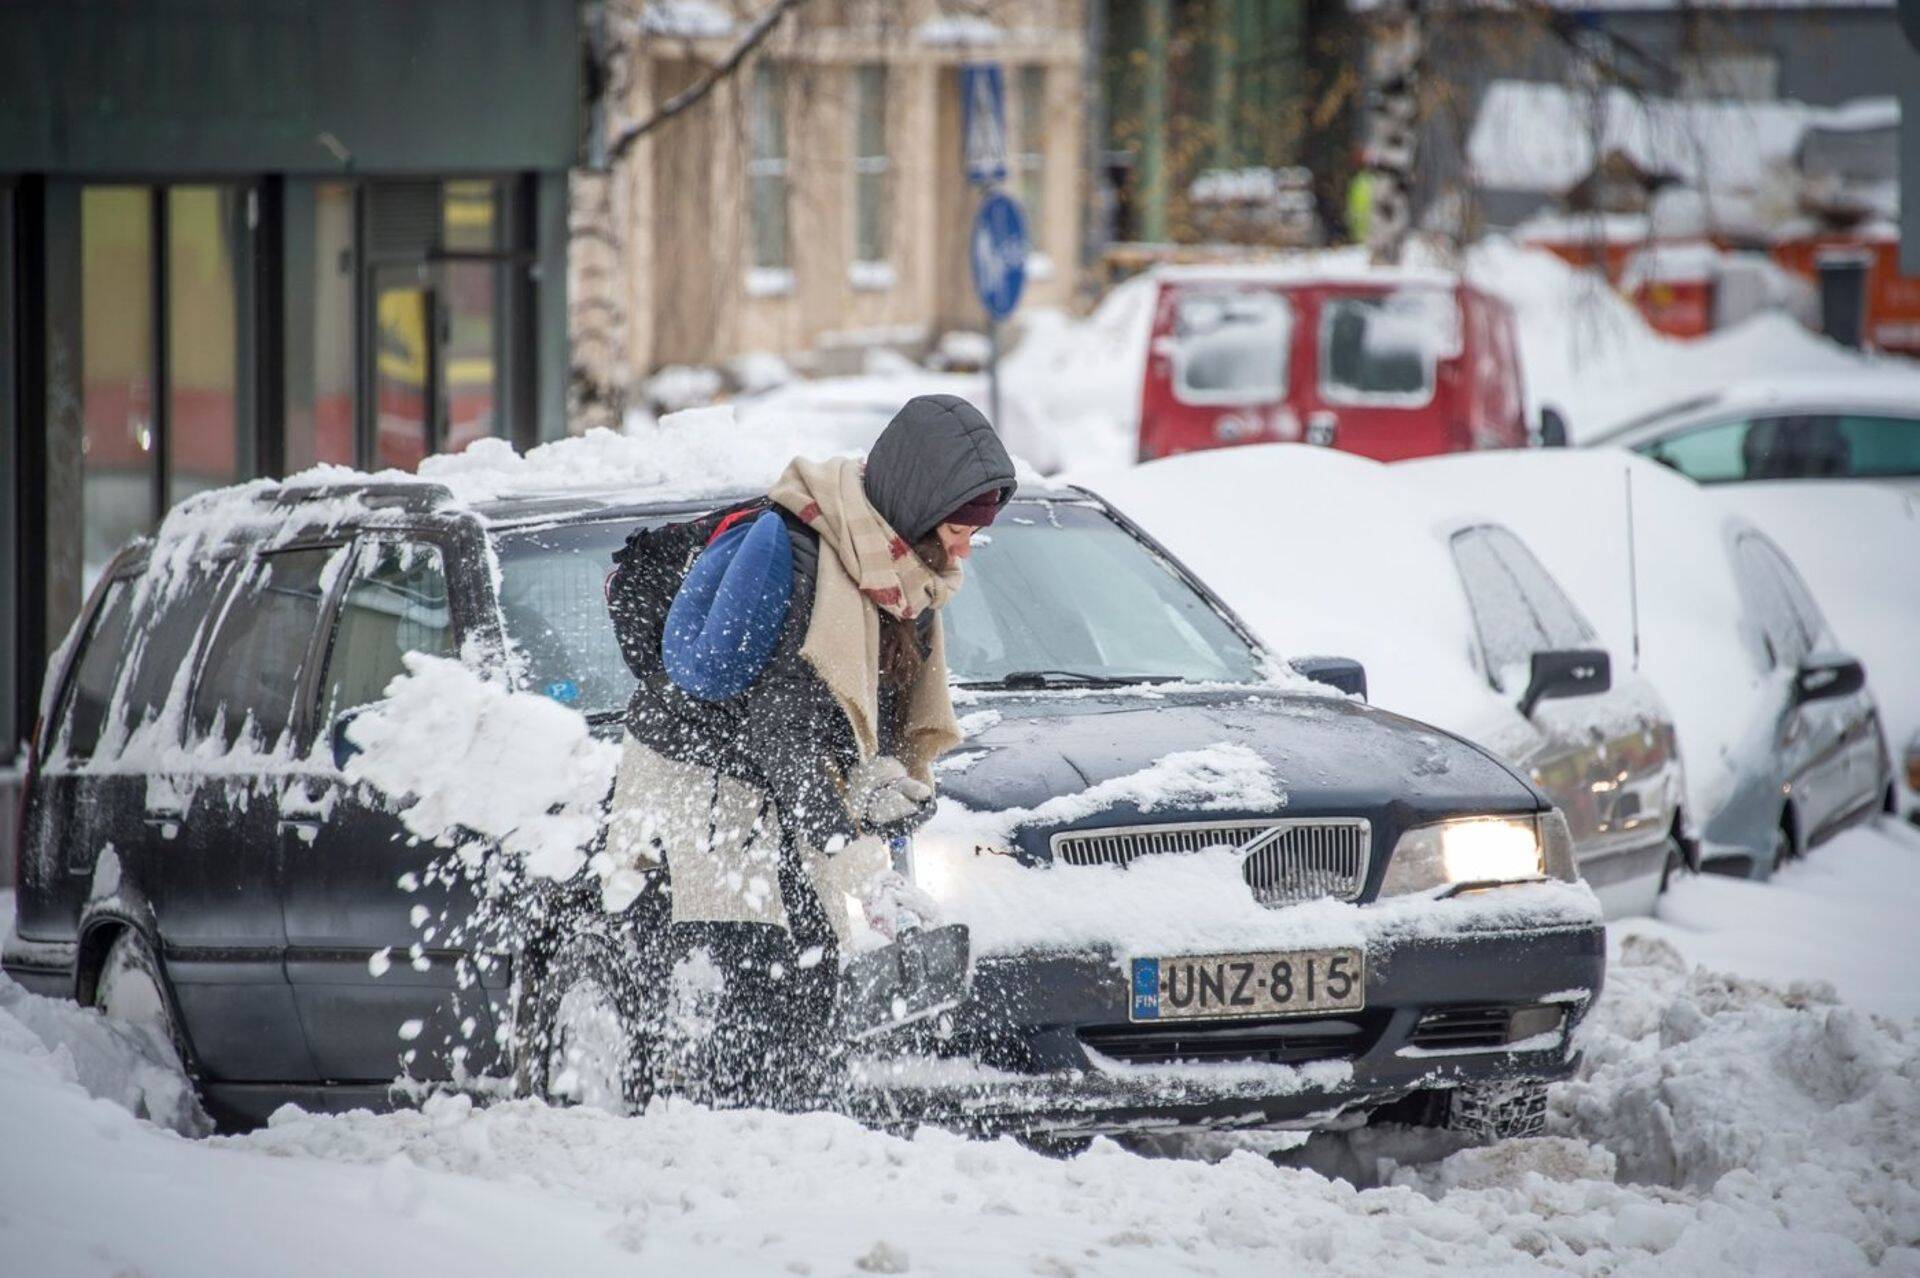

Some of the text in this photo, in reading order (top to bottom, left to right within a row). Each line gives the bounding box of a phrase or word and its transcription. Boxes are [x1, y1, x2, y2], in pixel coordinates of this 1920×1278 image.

[552, 683, 567, 696] P
[1168, 956, 1351, 1008] UNZ-815
[1135, 994, 1157, 1008] FIN
